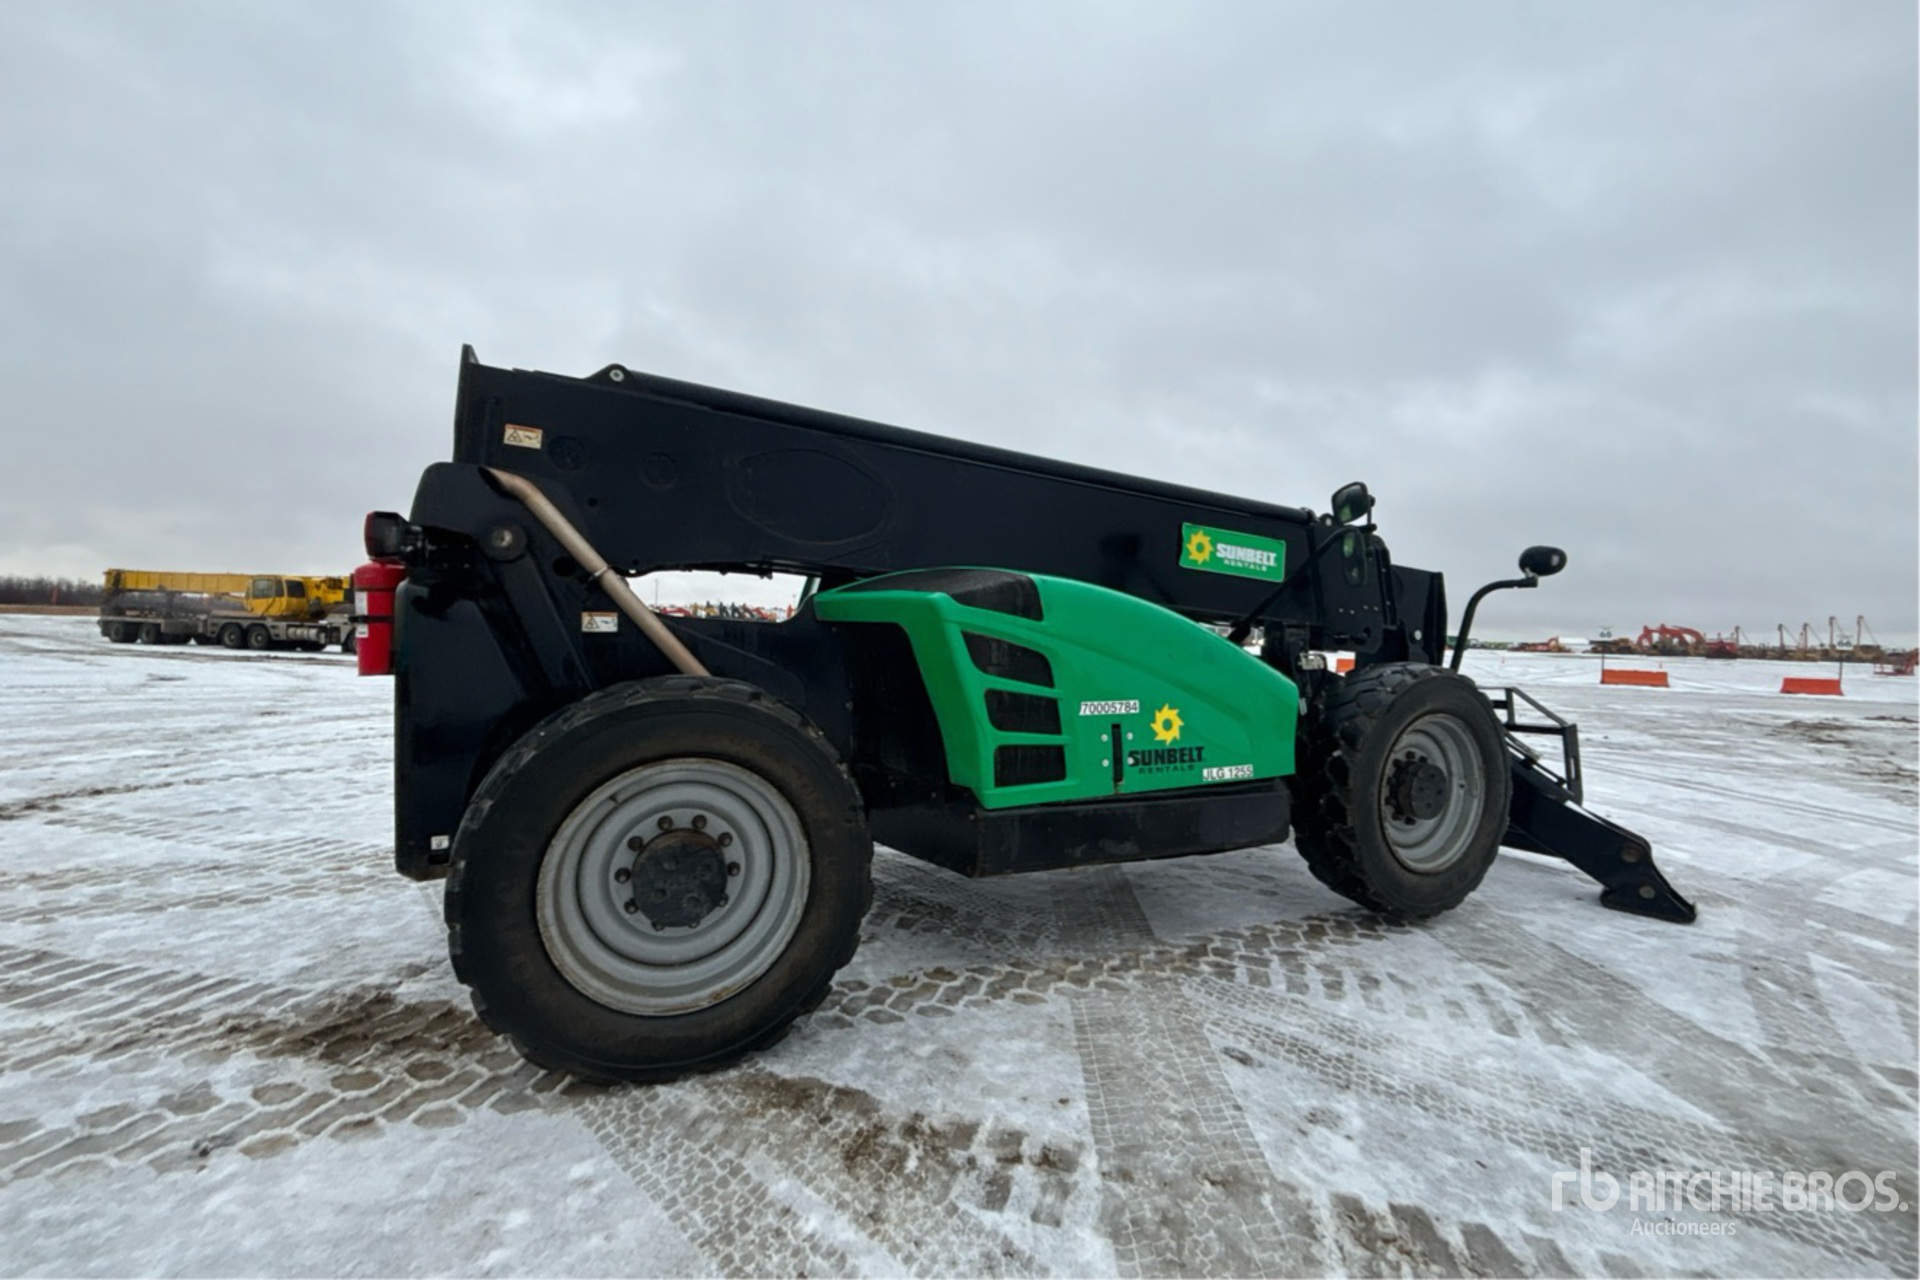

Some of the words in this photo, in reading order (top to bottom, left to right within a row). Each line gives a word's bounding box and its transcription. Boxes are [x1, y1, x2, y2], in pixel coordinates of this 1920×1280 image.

[1216, 543, 1277, 567] SUNBELT
[1223, 559, 1268, 572] RENTALS
[1081, 701, 1138, 714] 70005784
[1128, 746, 1205, 767] SUNBELT
[1138, 764, 1195, 774] RENTALS
[1203, 768, 1225, 780] JLG
[1229, 765, 1253, 778] 1255
